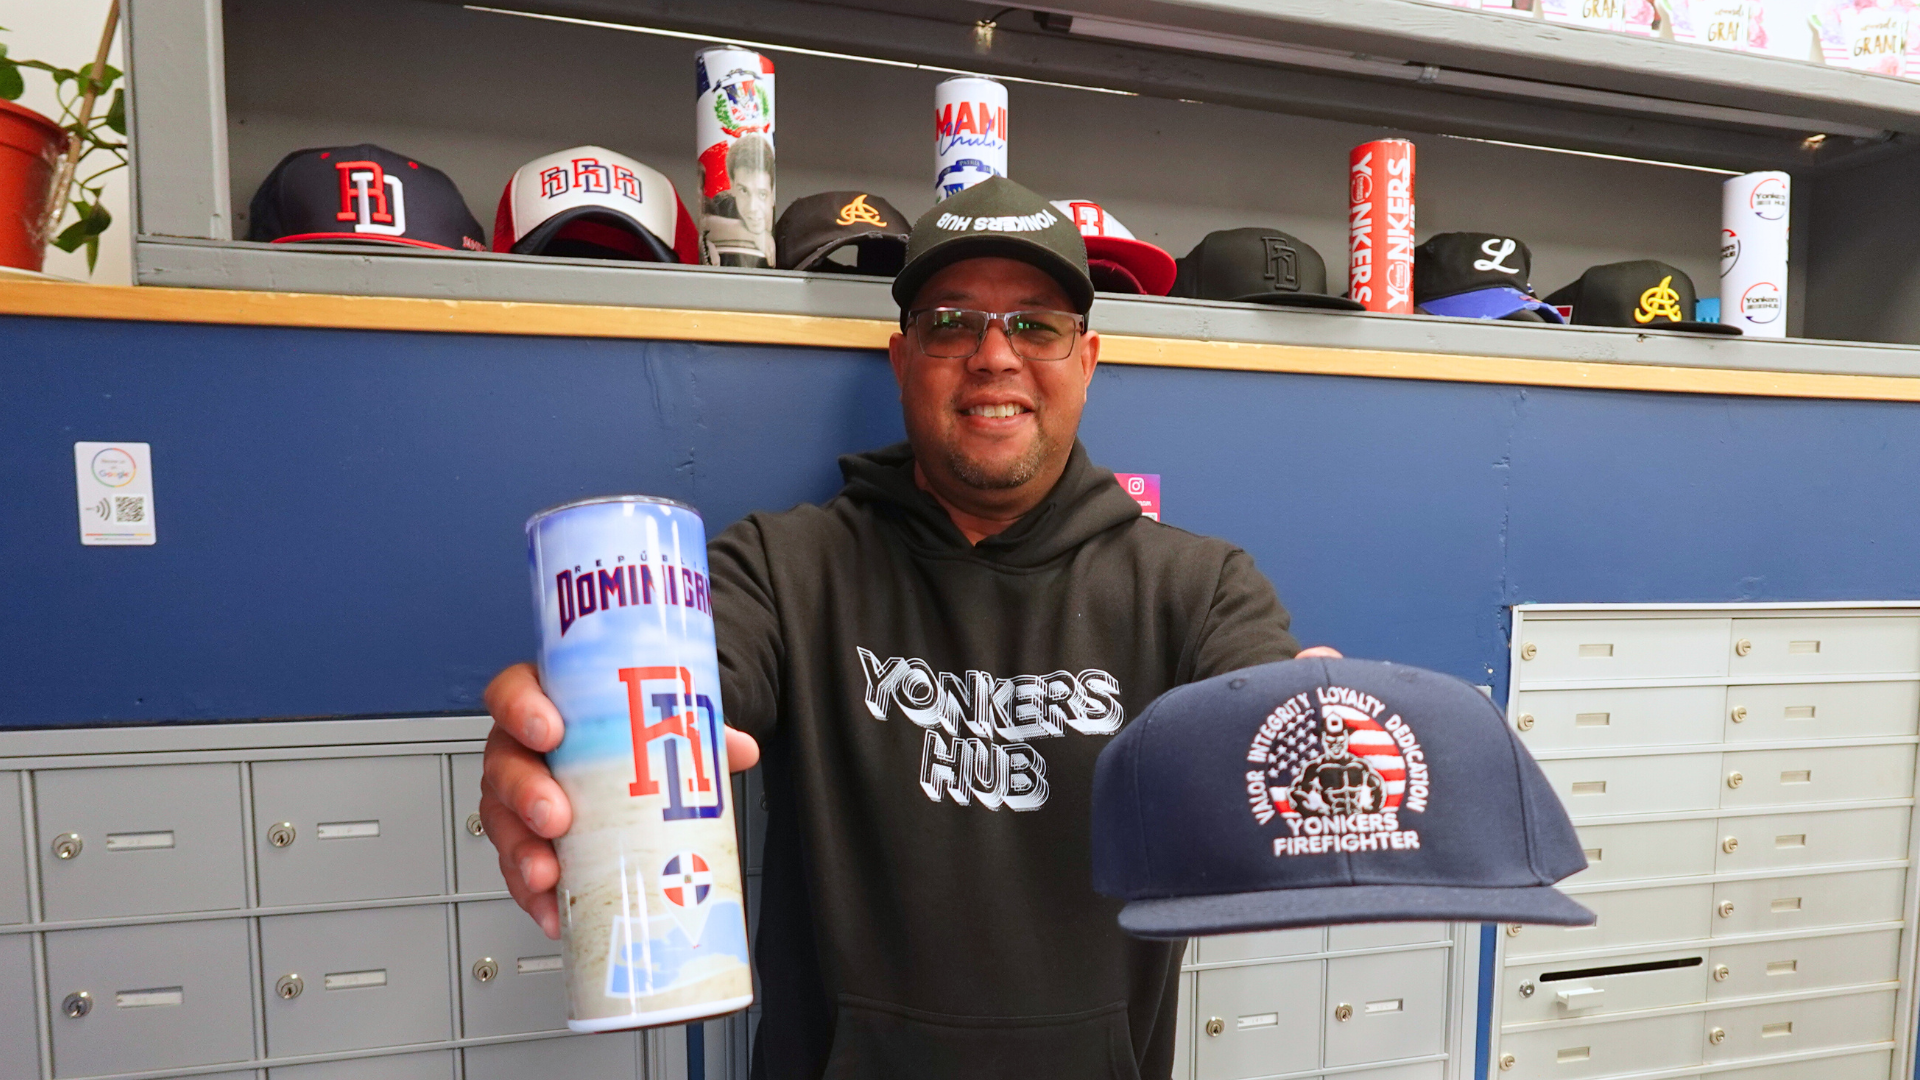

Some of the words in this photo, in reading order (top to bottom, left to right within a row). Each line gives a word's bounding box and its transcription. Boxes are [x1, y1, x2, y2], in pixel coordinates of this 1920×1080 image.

[935, 101, 1006, 142] MAMI
[936, 212, 973, 232] HUB
[974, 208, 1059, 232] YONKERS
[1473, 238, 1520, 275] L
[856, 645, 1126, 743] YONKERS
[1316, 686, 1386, 718] LOYALTY
[618, 666, 725, 822] RD
[1247, 692, 1311, 763] INTEGRITY
[919, 729, 1050, 812] HUB
[1384, 713, 1430, 814] DEDICATION
[1246, 769, 1276, 826] VALOR
[1273, 830, 1421, 857] FIREFIGHTER
[1286, 813, 1400, 836] YONKERS
